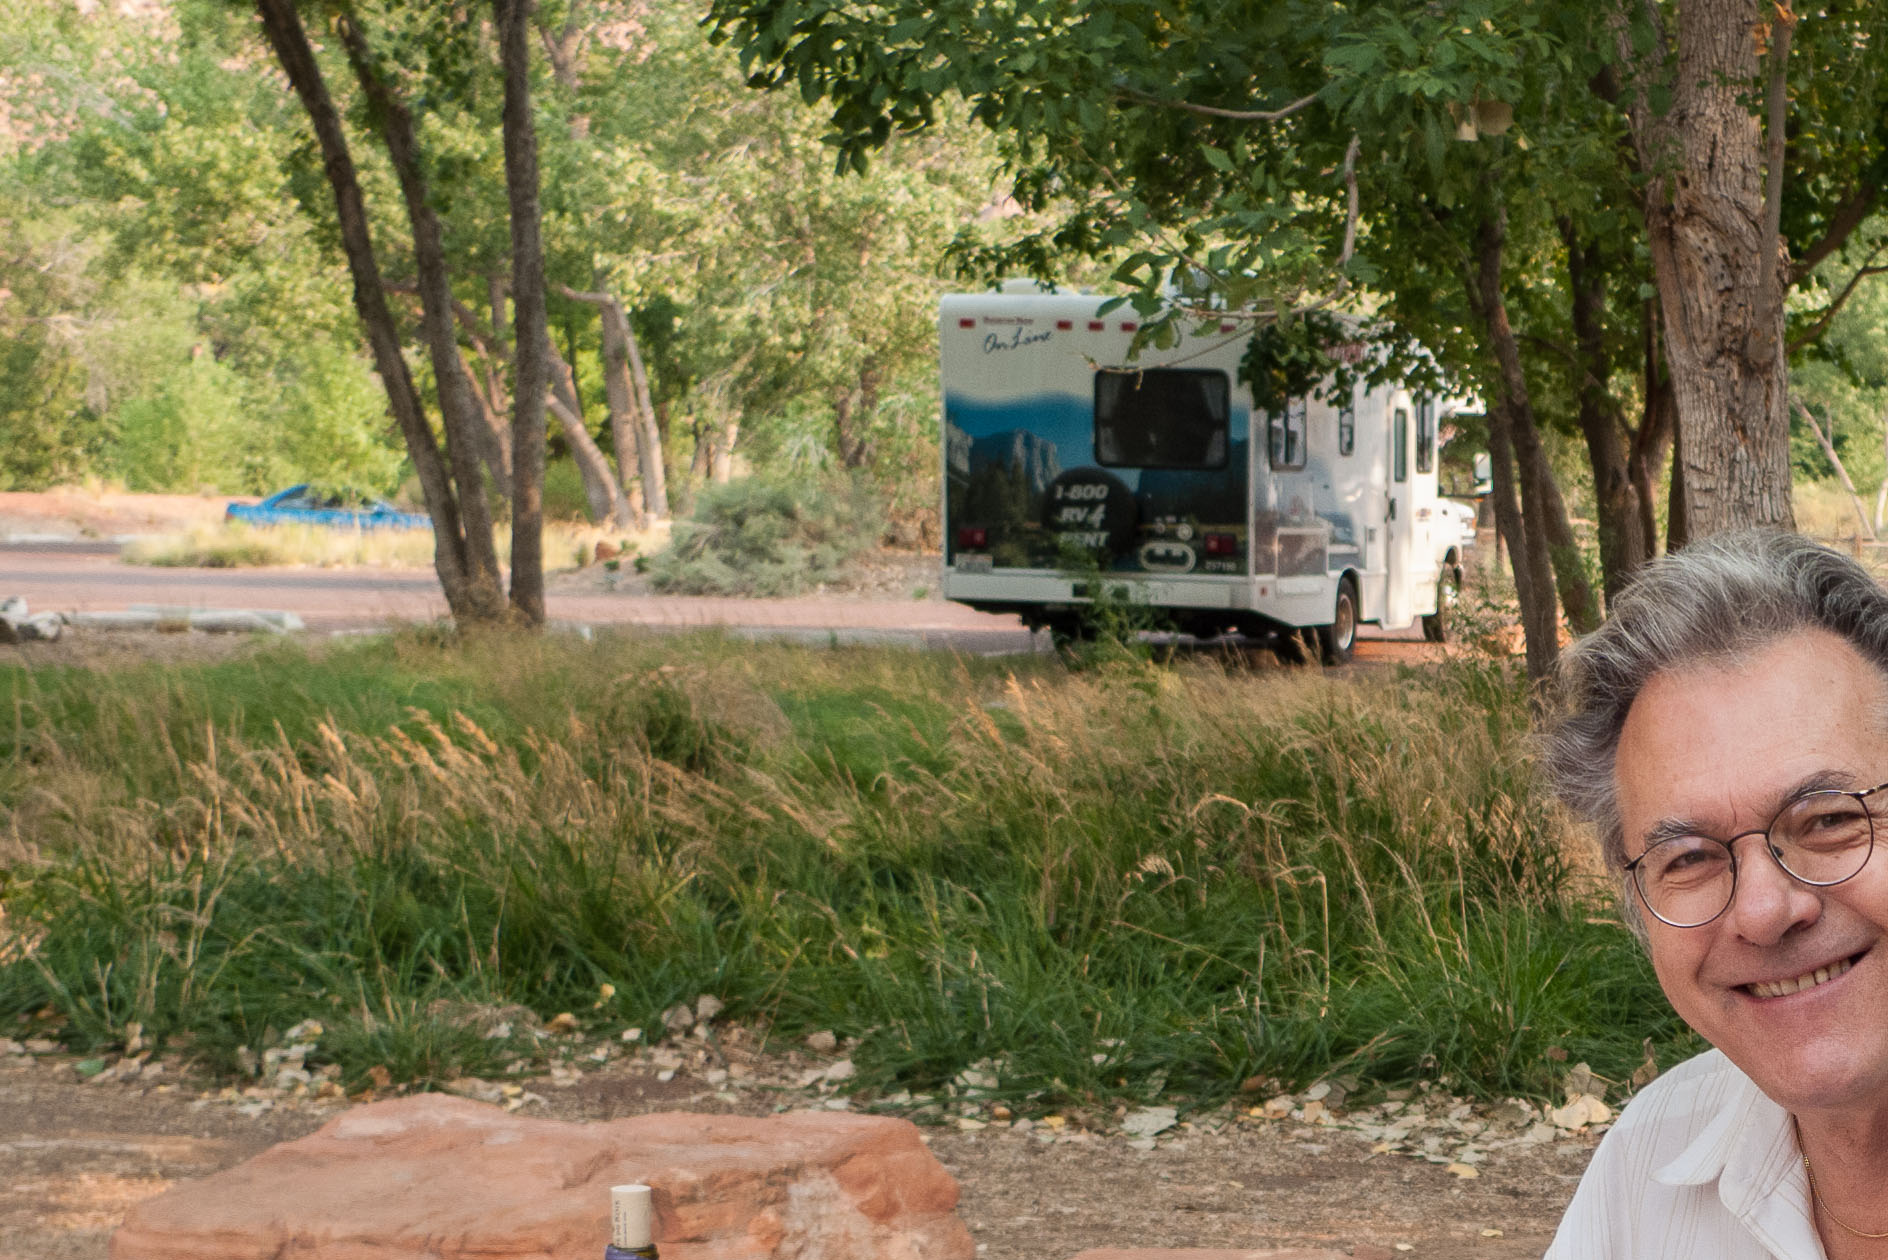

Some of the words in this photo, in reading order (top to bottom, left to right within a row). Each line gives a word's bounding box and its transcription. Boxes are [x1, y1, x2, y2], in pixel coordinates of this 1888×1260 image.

[1056, 484, 1109, 500] 1-800
[1061, 506, 1089, 522] RV
[1087, 503, 1106, 529] 4
